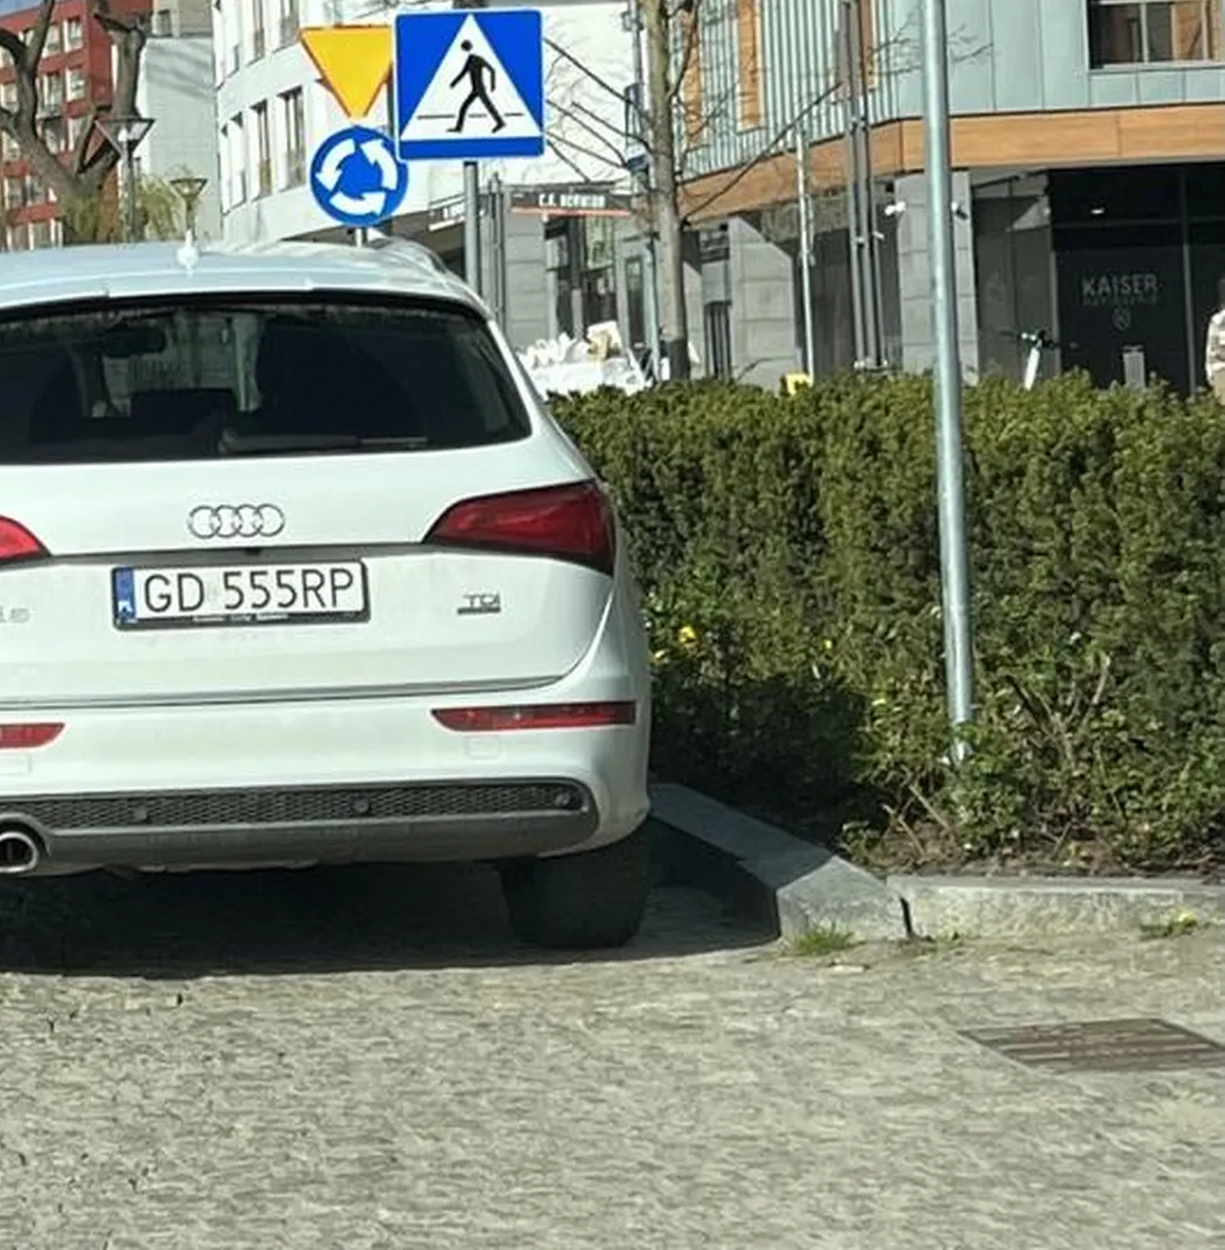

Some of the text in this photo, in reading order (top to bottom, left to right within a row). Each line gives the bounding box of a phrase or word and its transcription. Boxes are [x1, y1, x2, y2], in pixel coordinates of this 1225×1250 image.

[1082, 273, 1159, 296] KAISER
[143, 568, 354, 613] GD 555RP
